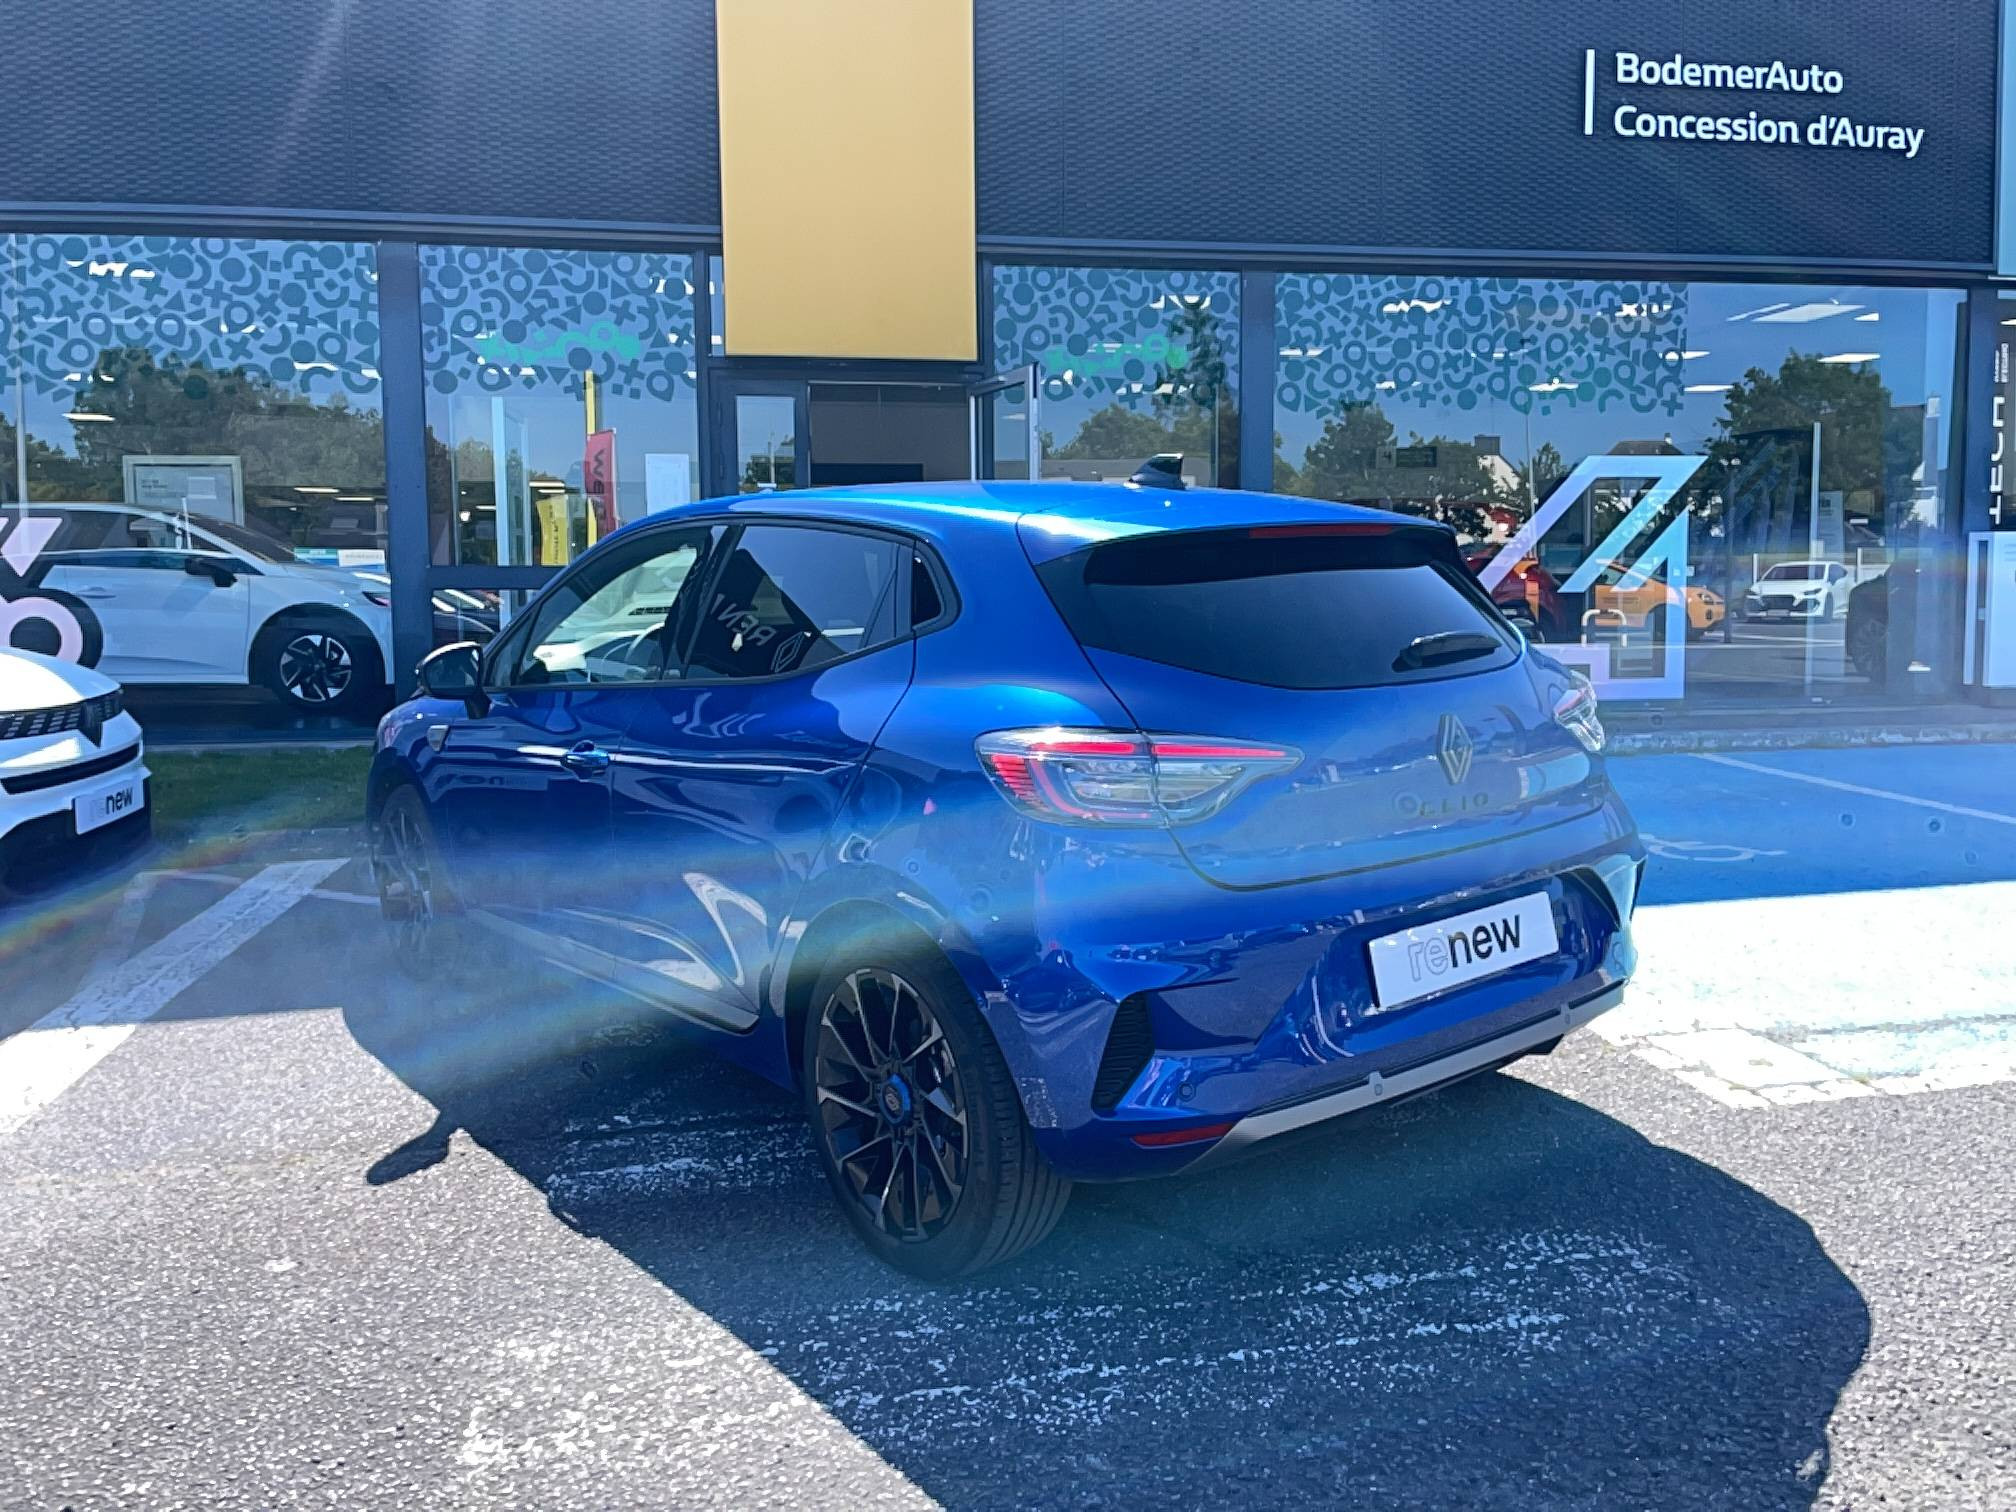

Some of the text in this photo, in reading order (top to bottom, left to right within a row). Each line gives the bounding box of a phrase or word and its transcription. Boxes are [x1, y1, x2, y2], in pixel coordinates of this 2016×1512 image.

[1615, 52, 1843, 93] BodemerAuto
[1613, 105, 1925, 158] Concession d'Auray
[1407, 914, 1520, 981] renew
